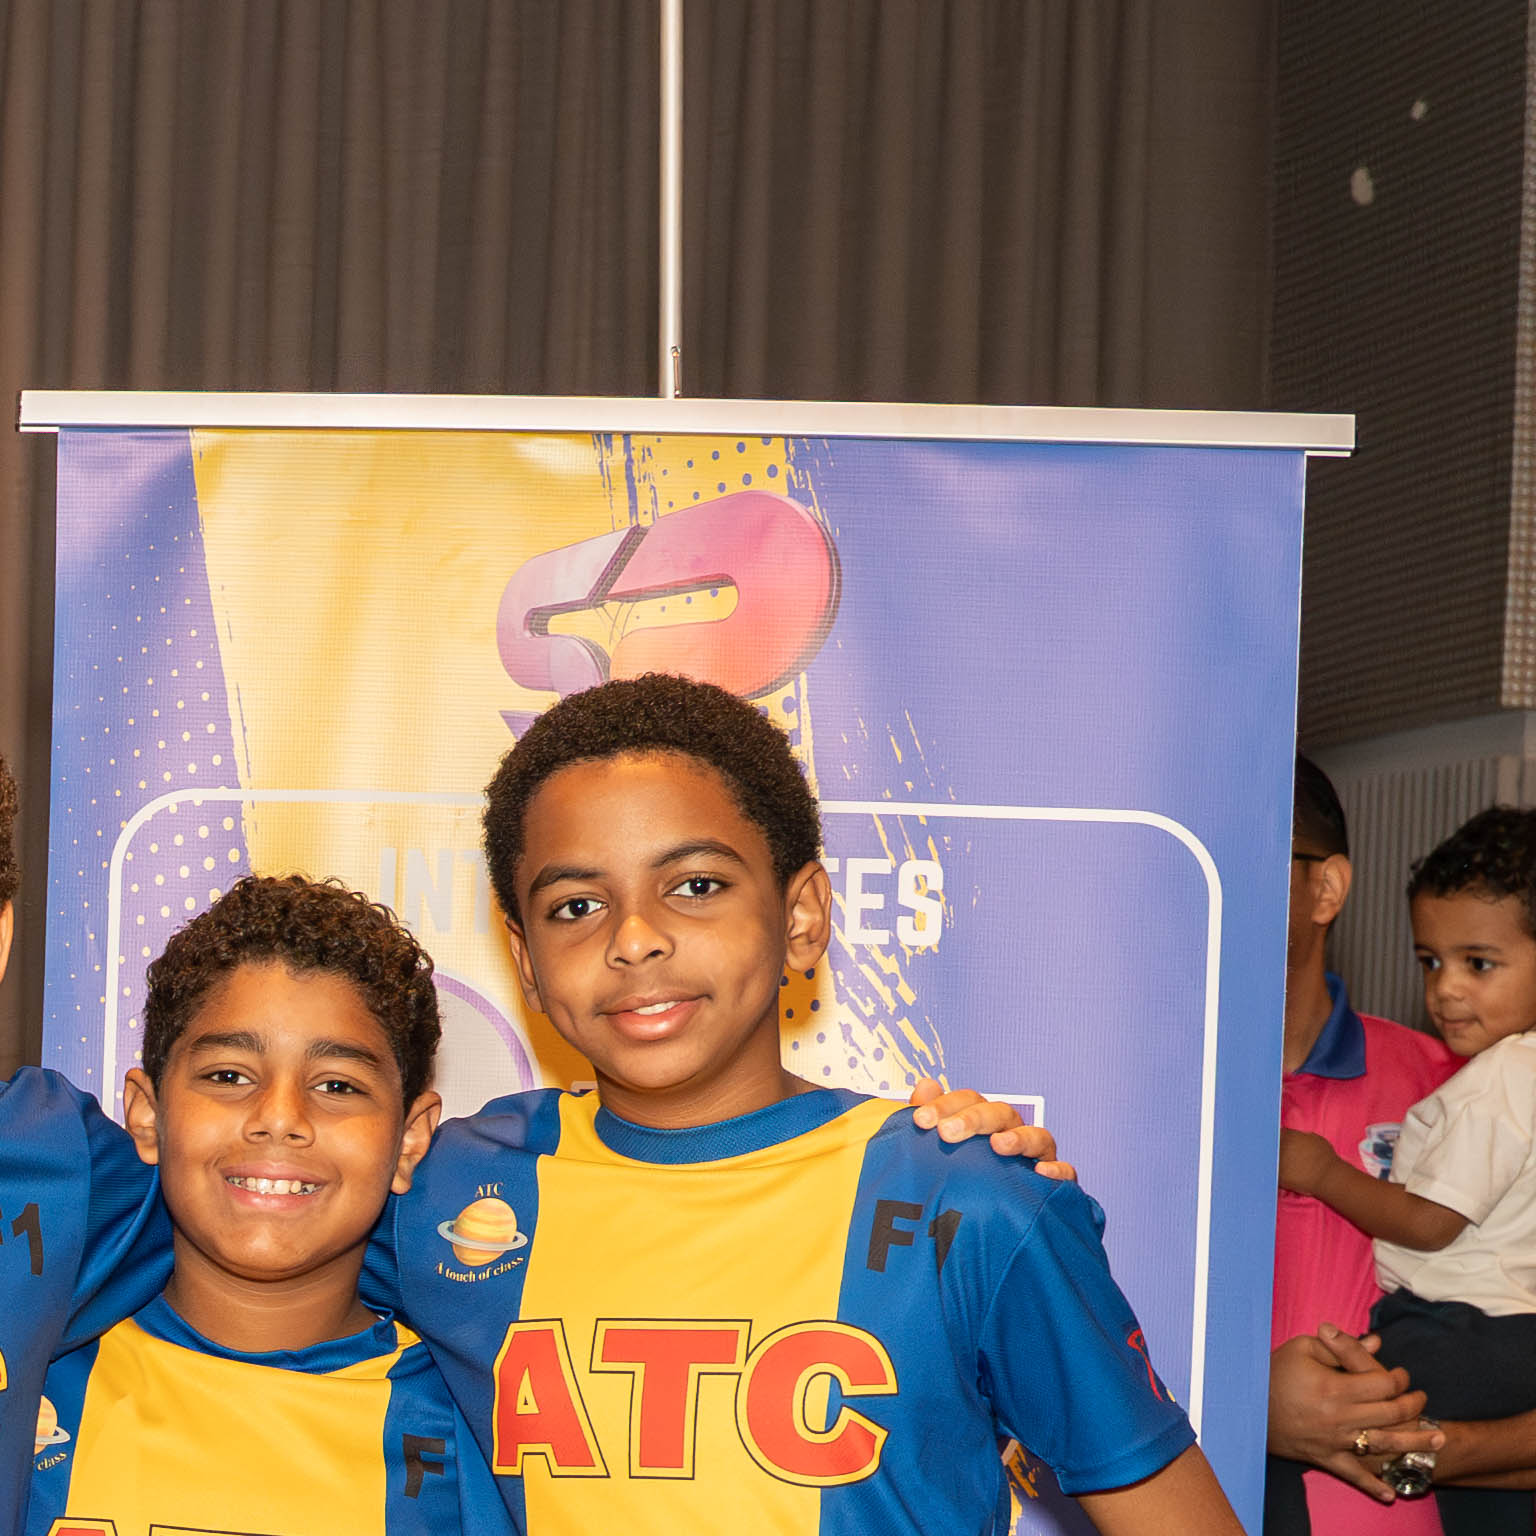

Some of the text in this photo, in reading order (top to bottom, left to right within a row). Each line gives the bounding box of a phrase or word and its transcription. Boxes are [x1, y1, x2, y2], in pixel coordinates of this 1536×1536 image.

[444, 1267, 476, 1283] touch
[478, 1267, 493, 1281] of
[491, 1316, 899, 1489] ATC
[36, 1451, 68, 1472] class
